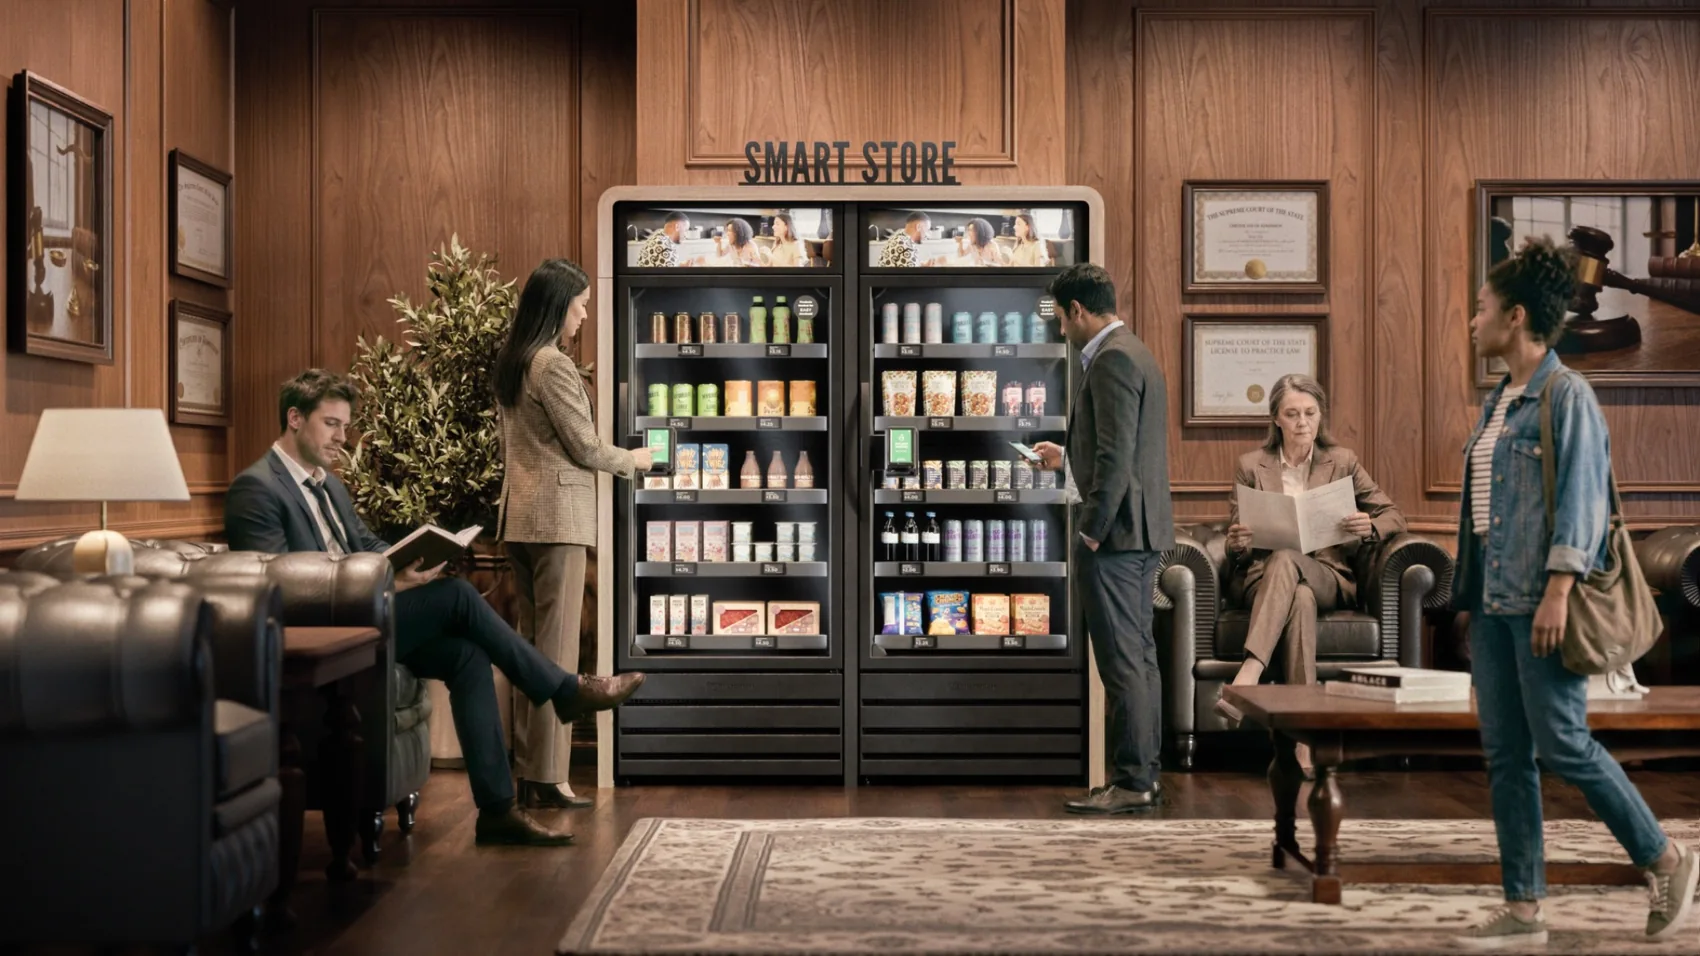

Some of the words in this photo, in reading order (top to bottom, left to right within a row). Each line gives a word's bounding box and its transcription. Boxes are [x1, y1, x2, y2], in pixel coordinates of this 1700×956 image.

[744, 141, 850, 183] SMART
[861, 141, 957, 183] STORE
[1207, 212, 1218, 220] THE
[1288, 211, 1304, 220] STATE
